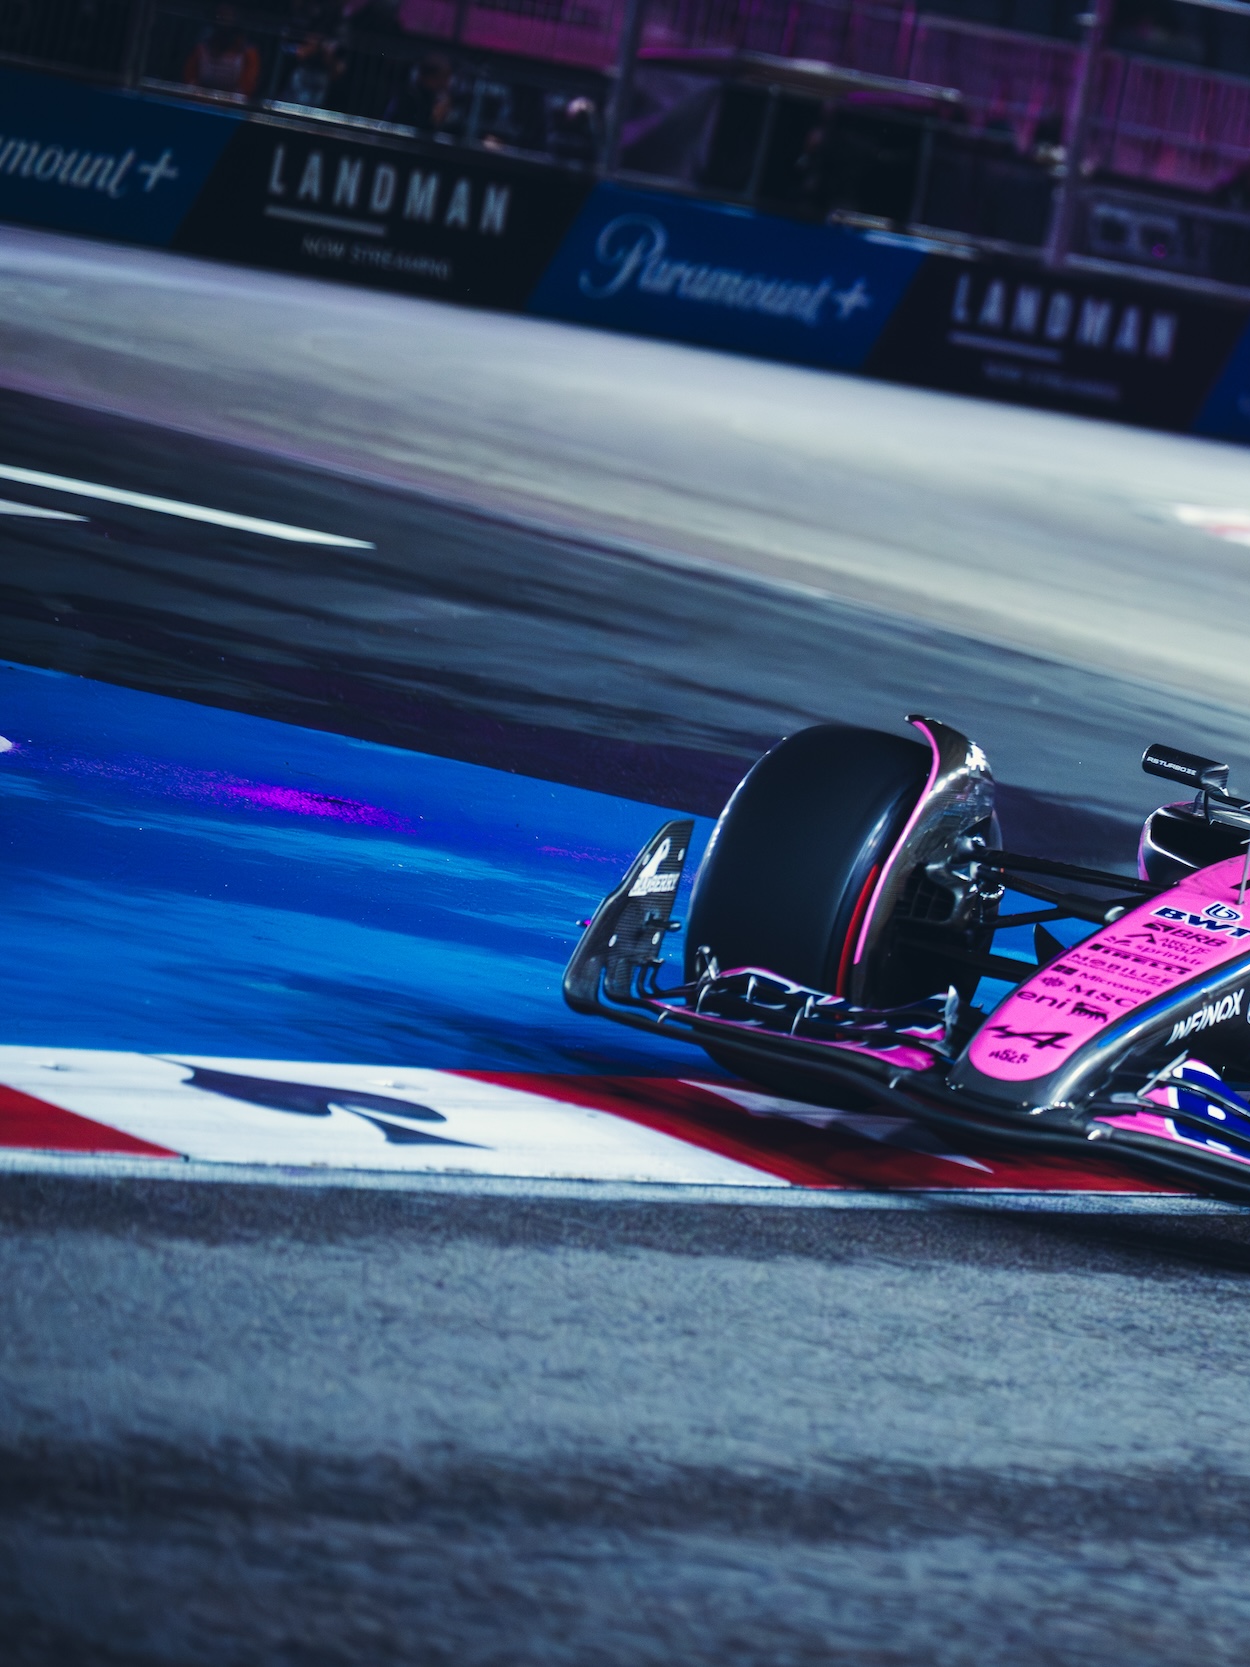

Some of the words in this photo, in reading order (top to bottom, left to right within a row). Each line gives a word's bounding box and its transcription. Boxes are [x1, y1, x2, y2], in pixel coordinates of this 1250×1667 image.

[267, 144, 512, 236] LANDMAN
[578, 213, 870, 325] Paramount+
[951, 272, 1178, 360] LANDMAN
[1171, 929, 1227, 947] BRB
[1016, 990, 1071, 1009] eni
[1068, 984, 1138, 1007] MSC
[1165, 988, 1244, 1046] INFINOX
